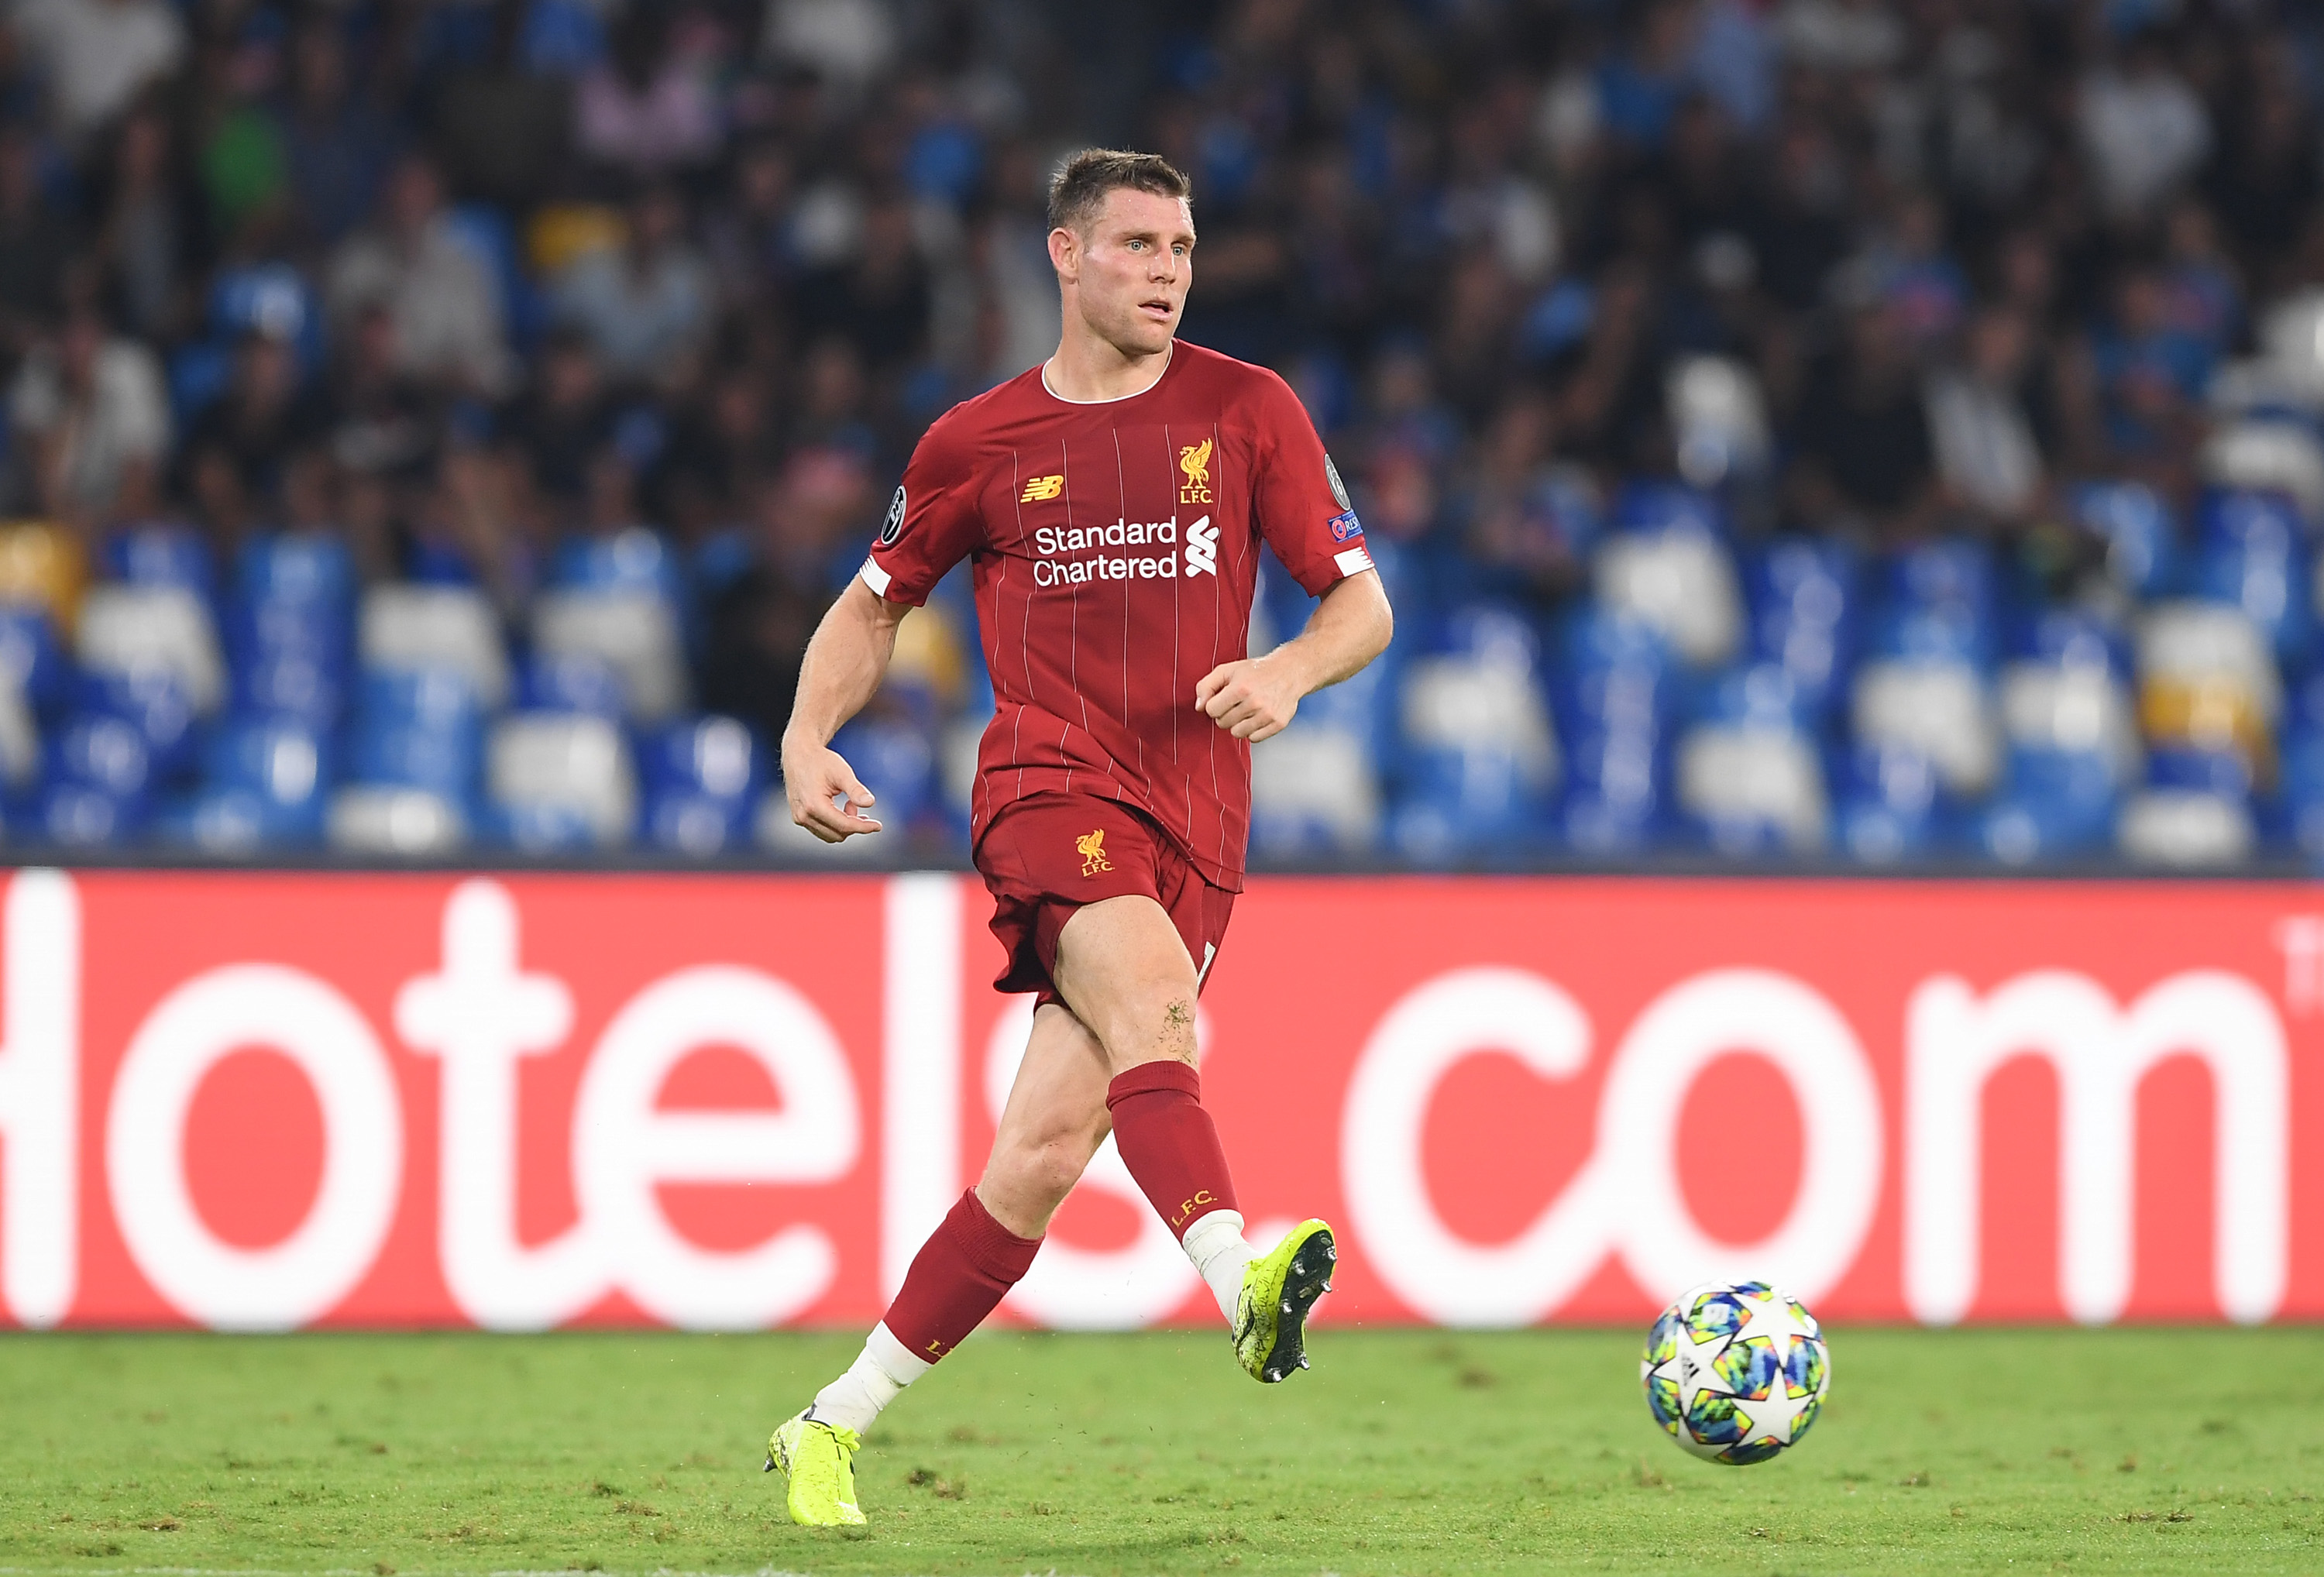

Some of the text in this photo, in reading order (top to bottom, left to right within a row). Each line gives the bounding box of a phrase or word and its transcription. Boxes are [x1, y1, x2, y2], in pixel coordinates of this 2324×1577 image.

[1180, 490, 1214, 504] L.F.C.
[1035, 515, 1177, 555] Standard
[1033, 550, 1177, 587] Chartered
[1081, 861, 1116, 878] L.F.C.
[1171, 1190, 1218, 1228] L.F.C.
